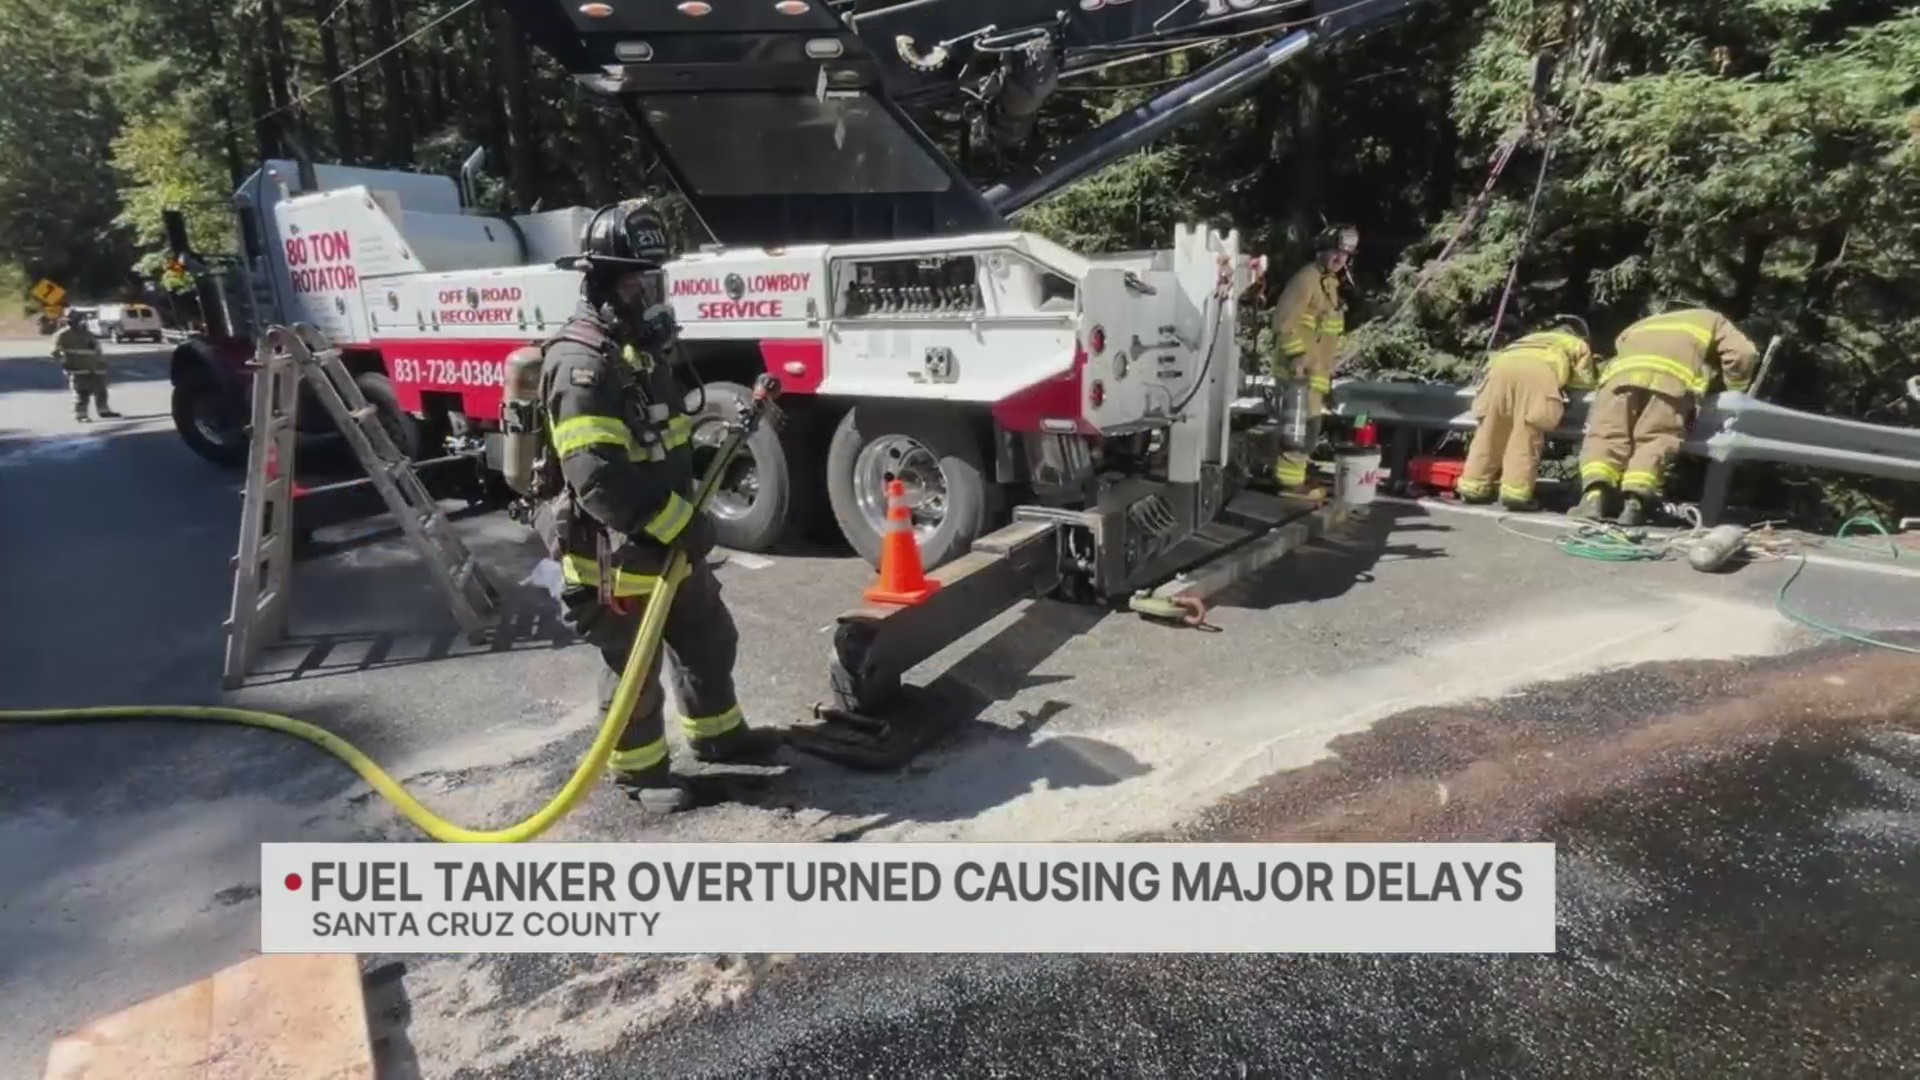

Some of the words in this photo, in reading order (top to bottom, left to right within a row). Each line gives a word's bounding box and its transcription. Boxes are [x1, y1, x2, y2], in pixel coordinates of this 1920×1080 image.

[286, 236, 305, 266] 80
[309, 230, 351, 262] TON
[290, 265, 357, 293] ROTATOR
[670, 276, 724, 297] ANDOLL
[747, 271, 811, 293] LOWBOY
[438, 289, 464, 304] OFF
[480, 286, 522, 302] ROAD
[439, 307, 514, 324] RECOVERY
[698, 299, 783, 319] SERVICE
[394, 358, 505, 387] 831-728-0384
